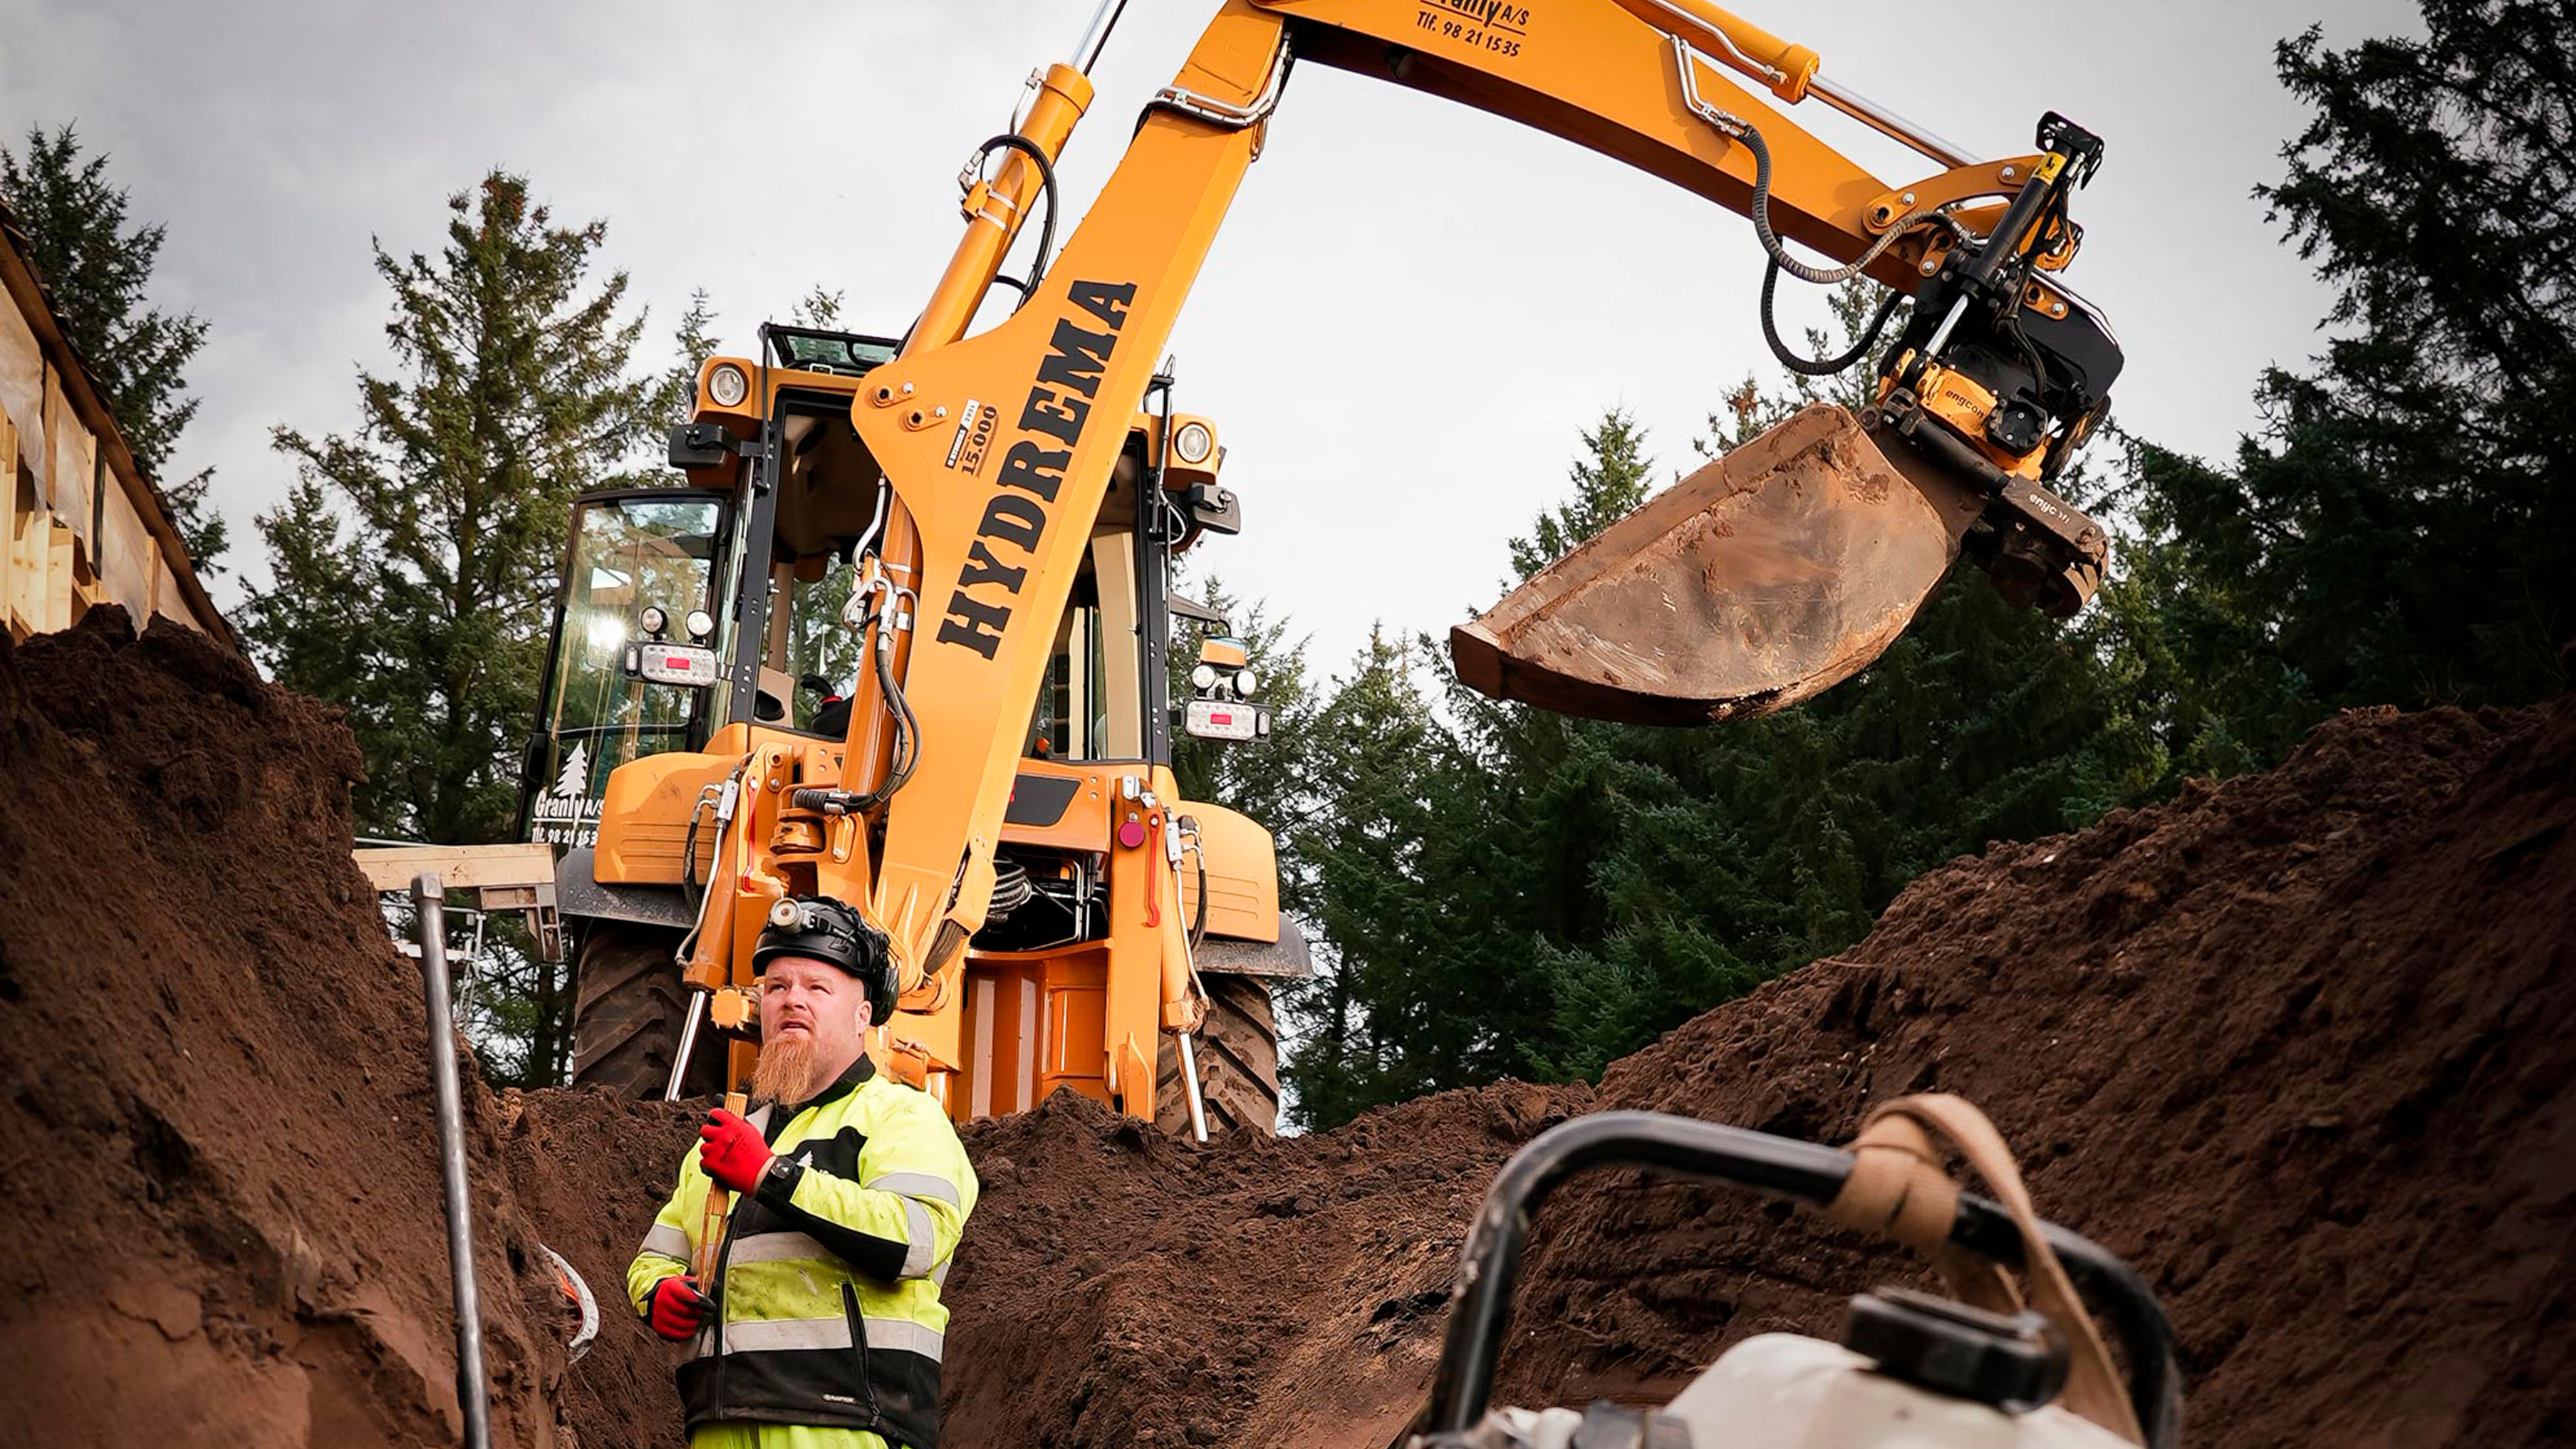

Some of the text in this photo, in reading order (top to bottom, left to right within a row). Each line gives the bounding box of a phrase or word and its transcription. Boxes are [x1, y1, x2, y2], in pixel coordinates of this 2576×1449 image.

[1417, 11, 1438, 31] Tlf.
[1443, 21, 1462, 38] 98
[1465, 29, 1482, 46] 21
[1500, 4, 1530, 26] A/S
[1946, 390, 1984, 419] engcon
[961, 406, 997, 476] 15.000
[936, 280, 1137, 660] HYDREMA
[535, 790, 585, 827] Granly
[548, 829, 561, 843] 98
[576, 829, 599, 848] 153
